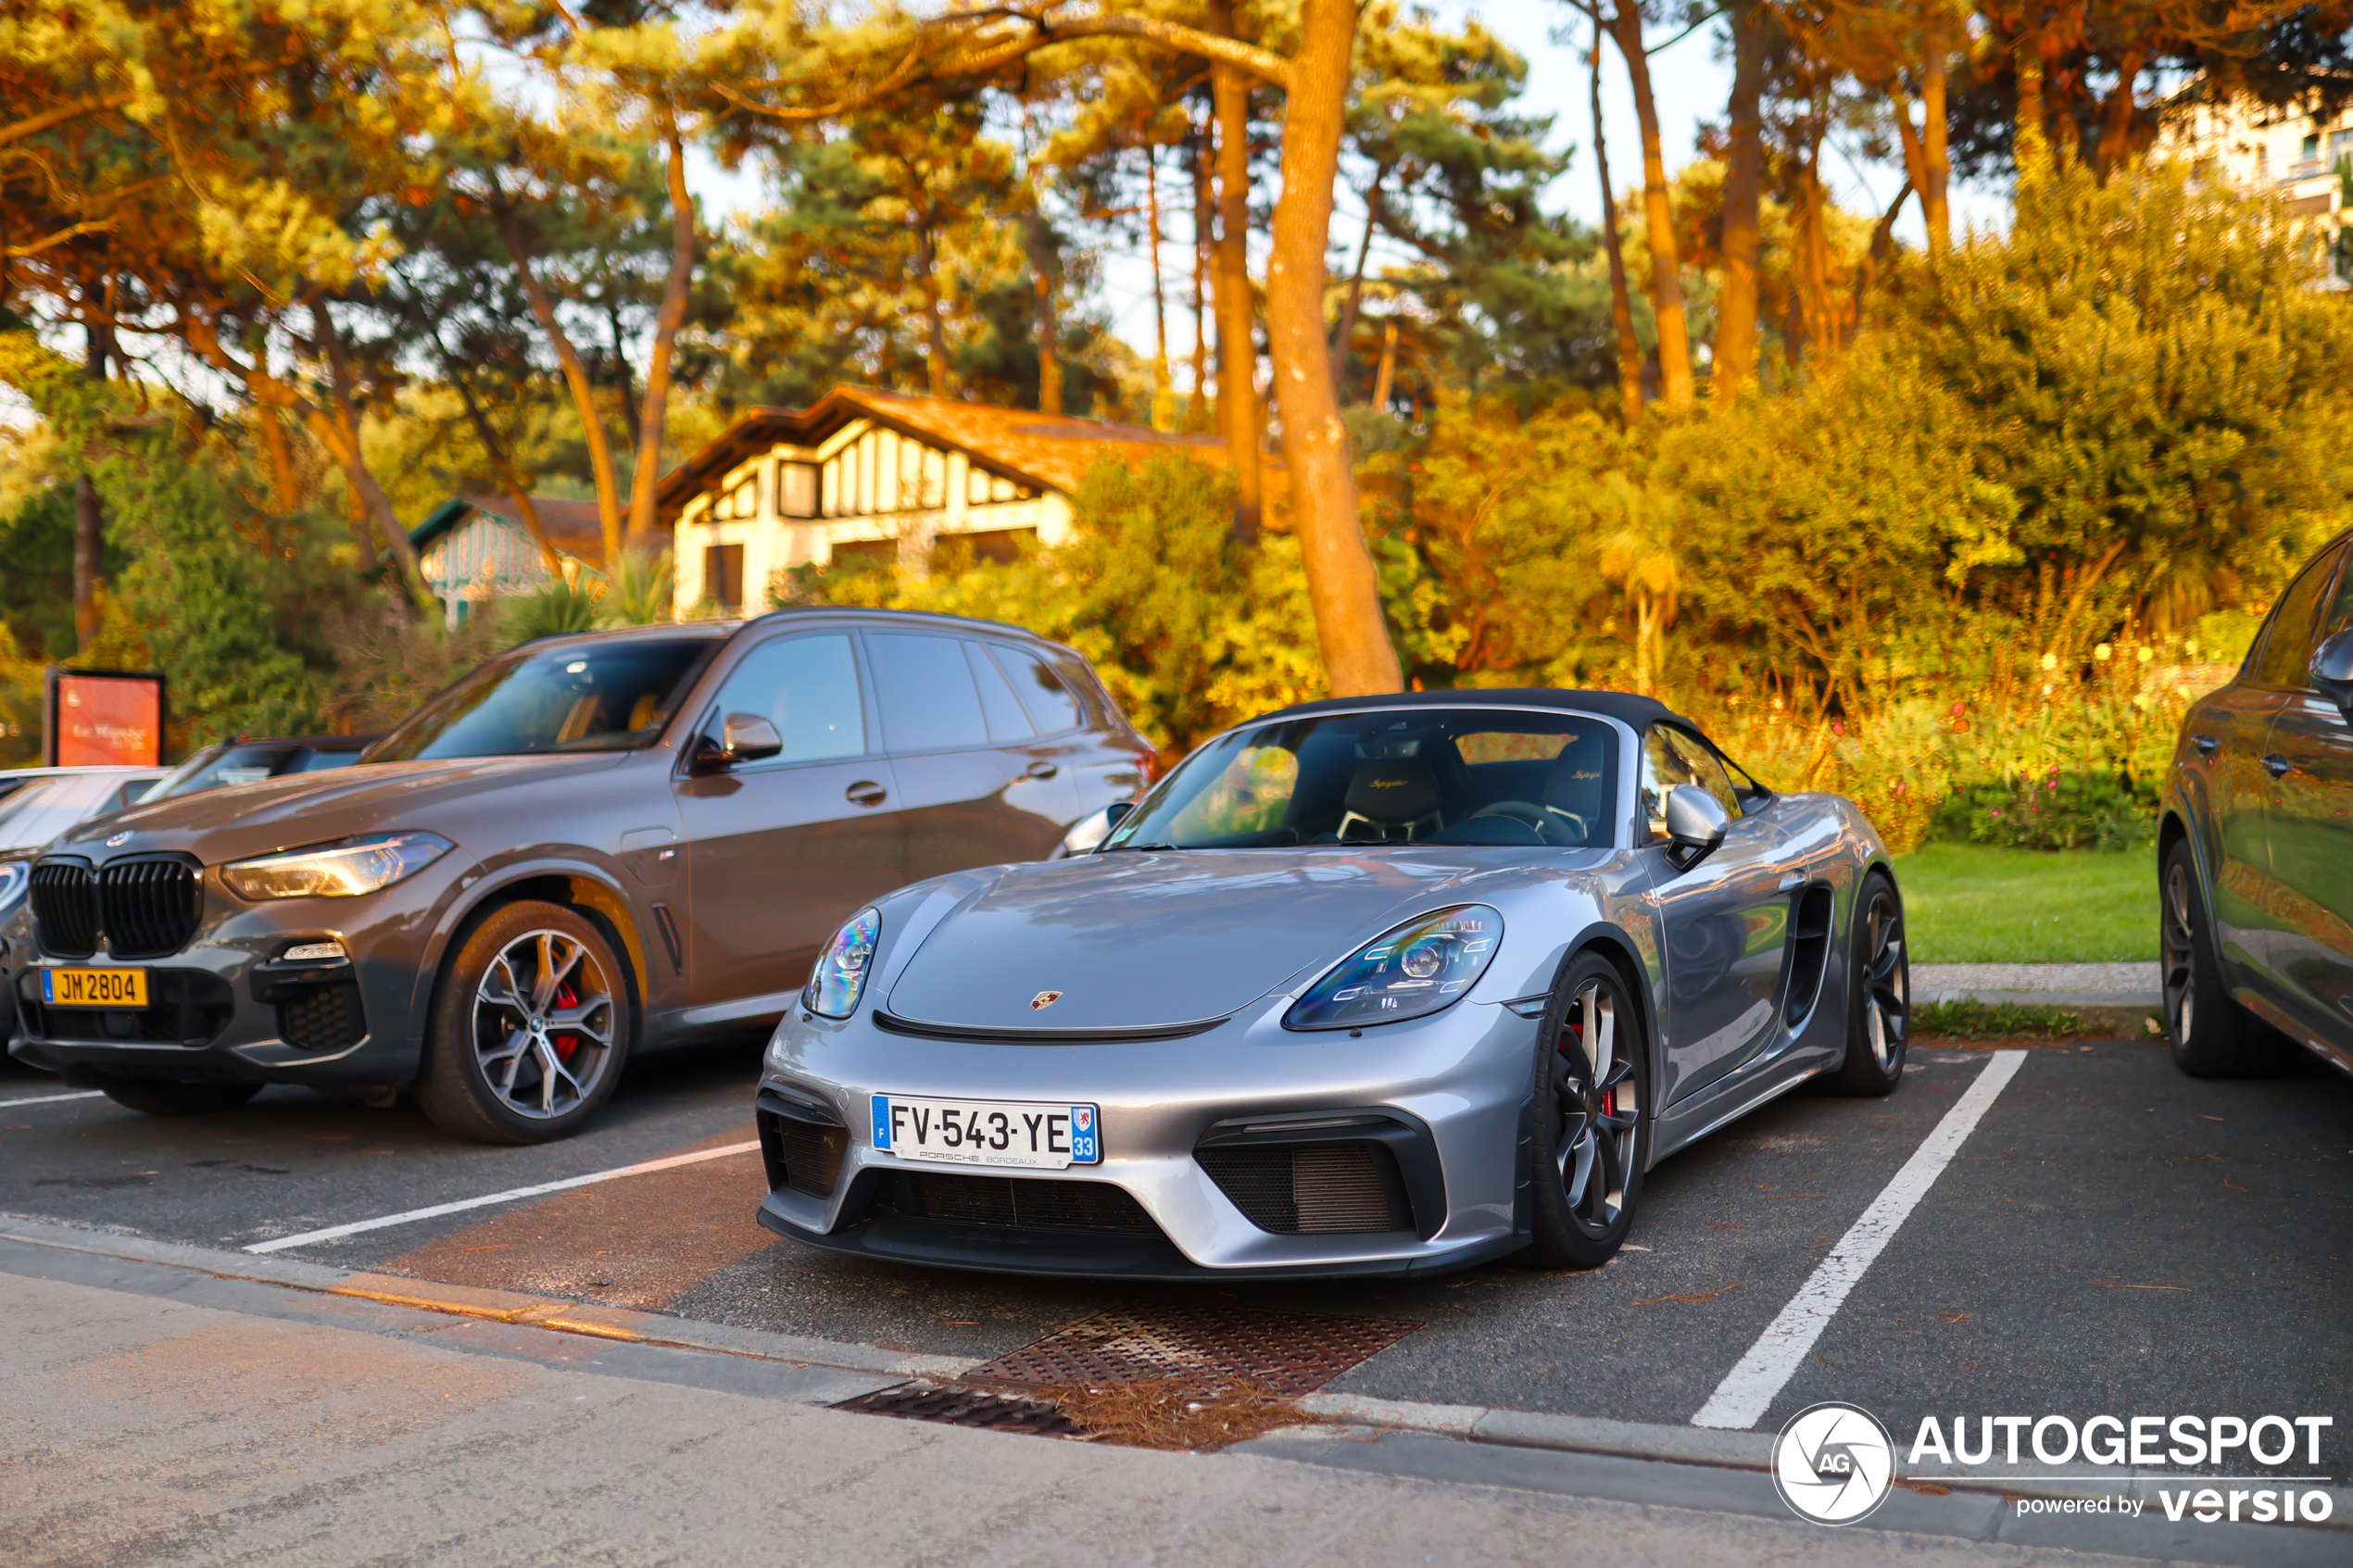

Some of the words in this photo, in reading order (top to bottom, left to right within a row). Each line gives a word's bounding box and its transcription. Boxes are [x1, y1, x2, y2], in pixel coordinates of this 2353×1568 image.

[878, 1127, 885, 1139] F
[891, 1105, 1071, 1154] FV-543-YE
[1074, 1136, 1093, 1156] 33
[919, 1151, 980, 1162] PORSCHE
[986, 1156, 1038, 1166] BORDEAUX
